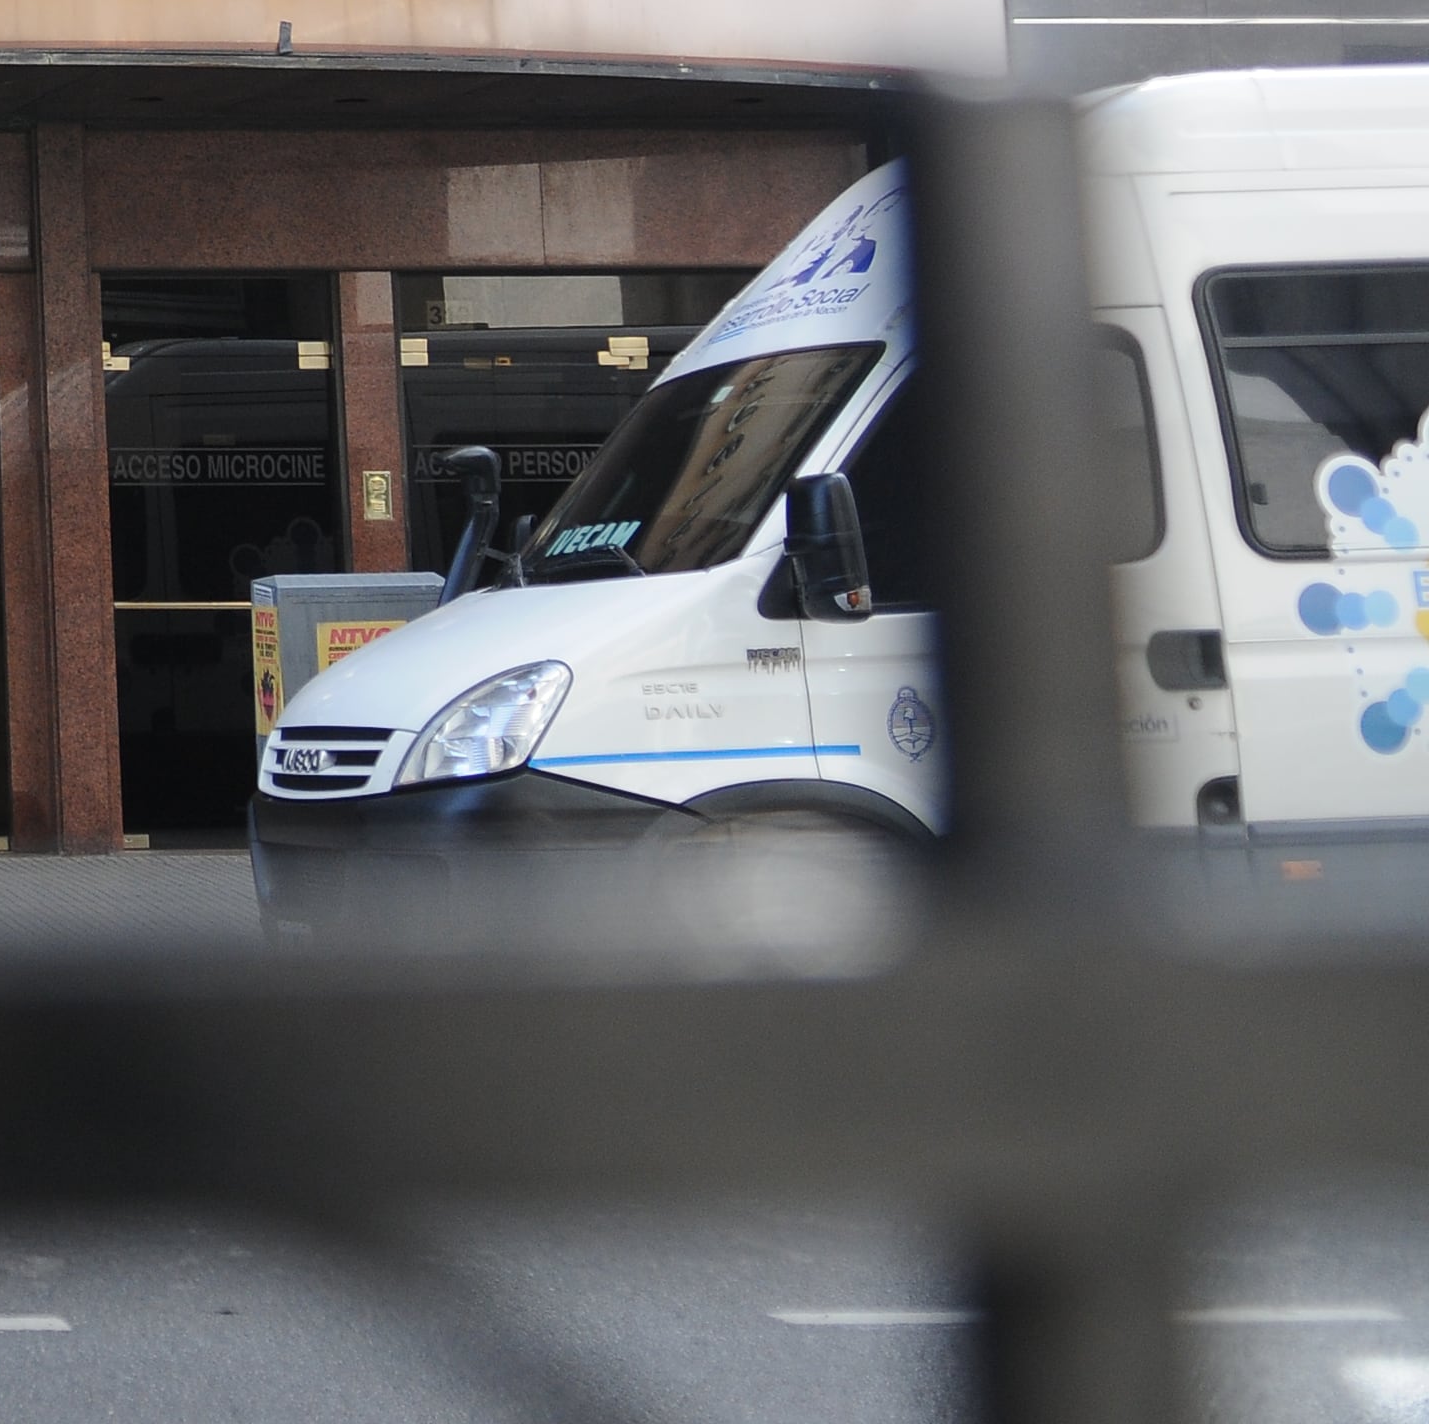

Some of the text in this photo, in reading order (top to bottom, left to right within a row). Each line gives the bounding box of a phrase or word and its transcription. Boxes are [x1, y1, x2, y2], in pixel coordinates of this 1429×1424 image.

[795, 282, 872, 310] Social
[113, 454, 326, 480] ACCESO MICROCINE
[645, 704, 725, 721] DAILY
